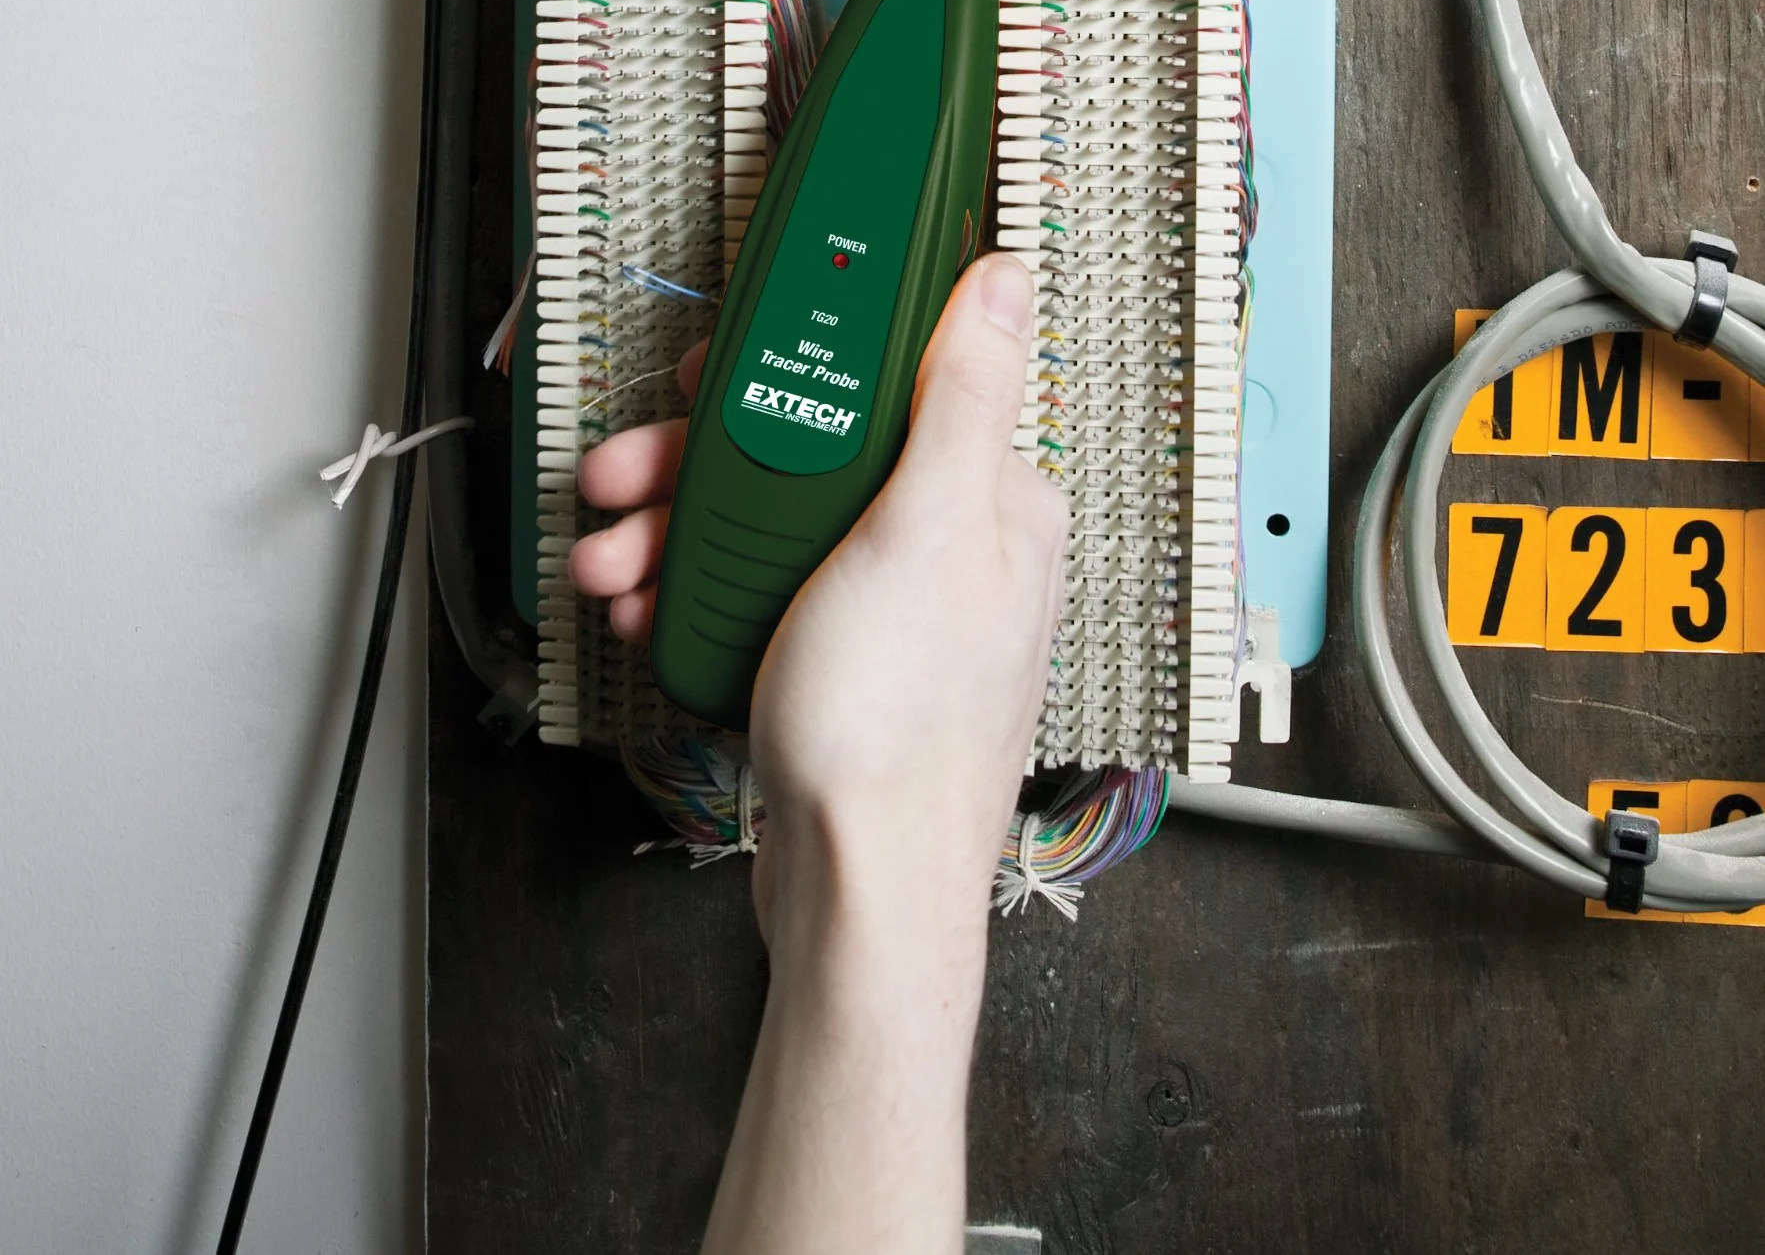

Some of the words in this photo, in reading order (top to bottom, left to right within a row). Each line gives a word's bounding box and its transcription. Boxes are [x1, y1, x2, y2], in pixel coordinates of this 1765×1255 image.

[828, 234, 867, 254] POWER
[810, 310, 838, 326] TG20
[797, 339, 834, 362] Wire
[760, 349, 811, 375] Tracer
[812, 365, 860, 391] Probe
[743, 381, 857, 430] EXTECH
[784, 412, 847, 437] INSTRUMENTS
